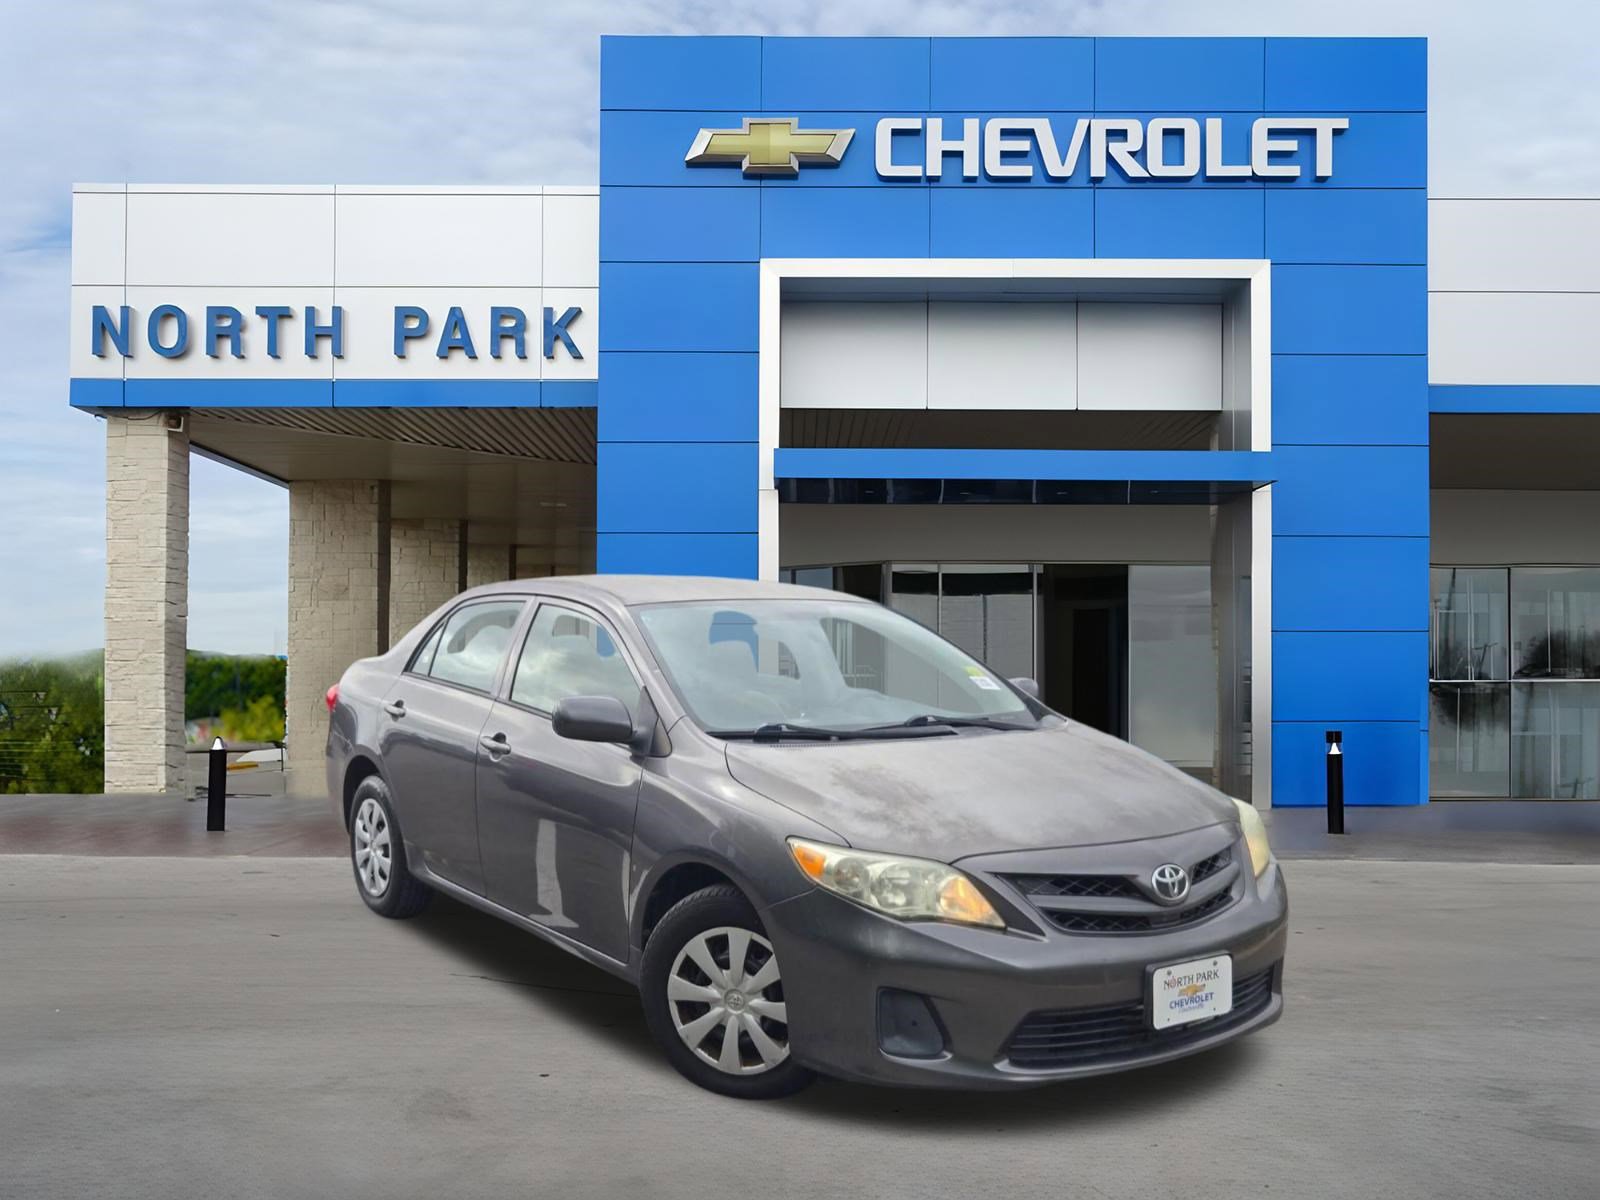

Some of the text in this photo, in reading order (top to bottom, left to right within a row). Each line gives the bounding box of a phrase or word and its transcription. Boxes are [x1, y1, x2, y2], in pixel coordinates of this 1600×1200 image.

[875, 117, 1349, 179] CHEVROLET
[91, 304, 584, 360] NORTH PARK
[1163, 969, 1220, 991] NORTH PARK
[1169, 992, 1214, 1009] CHEVROLET
